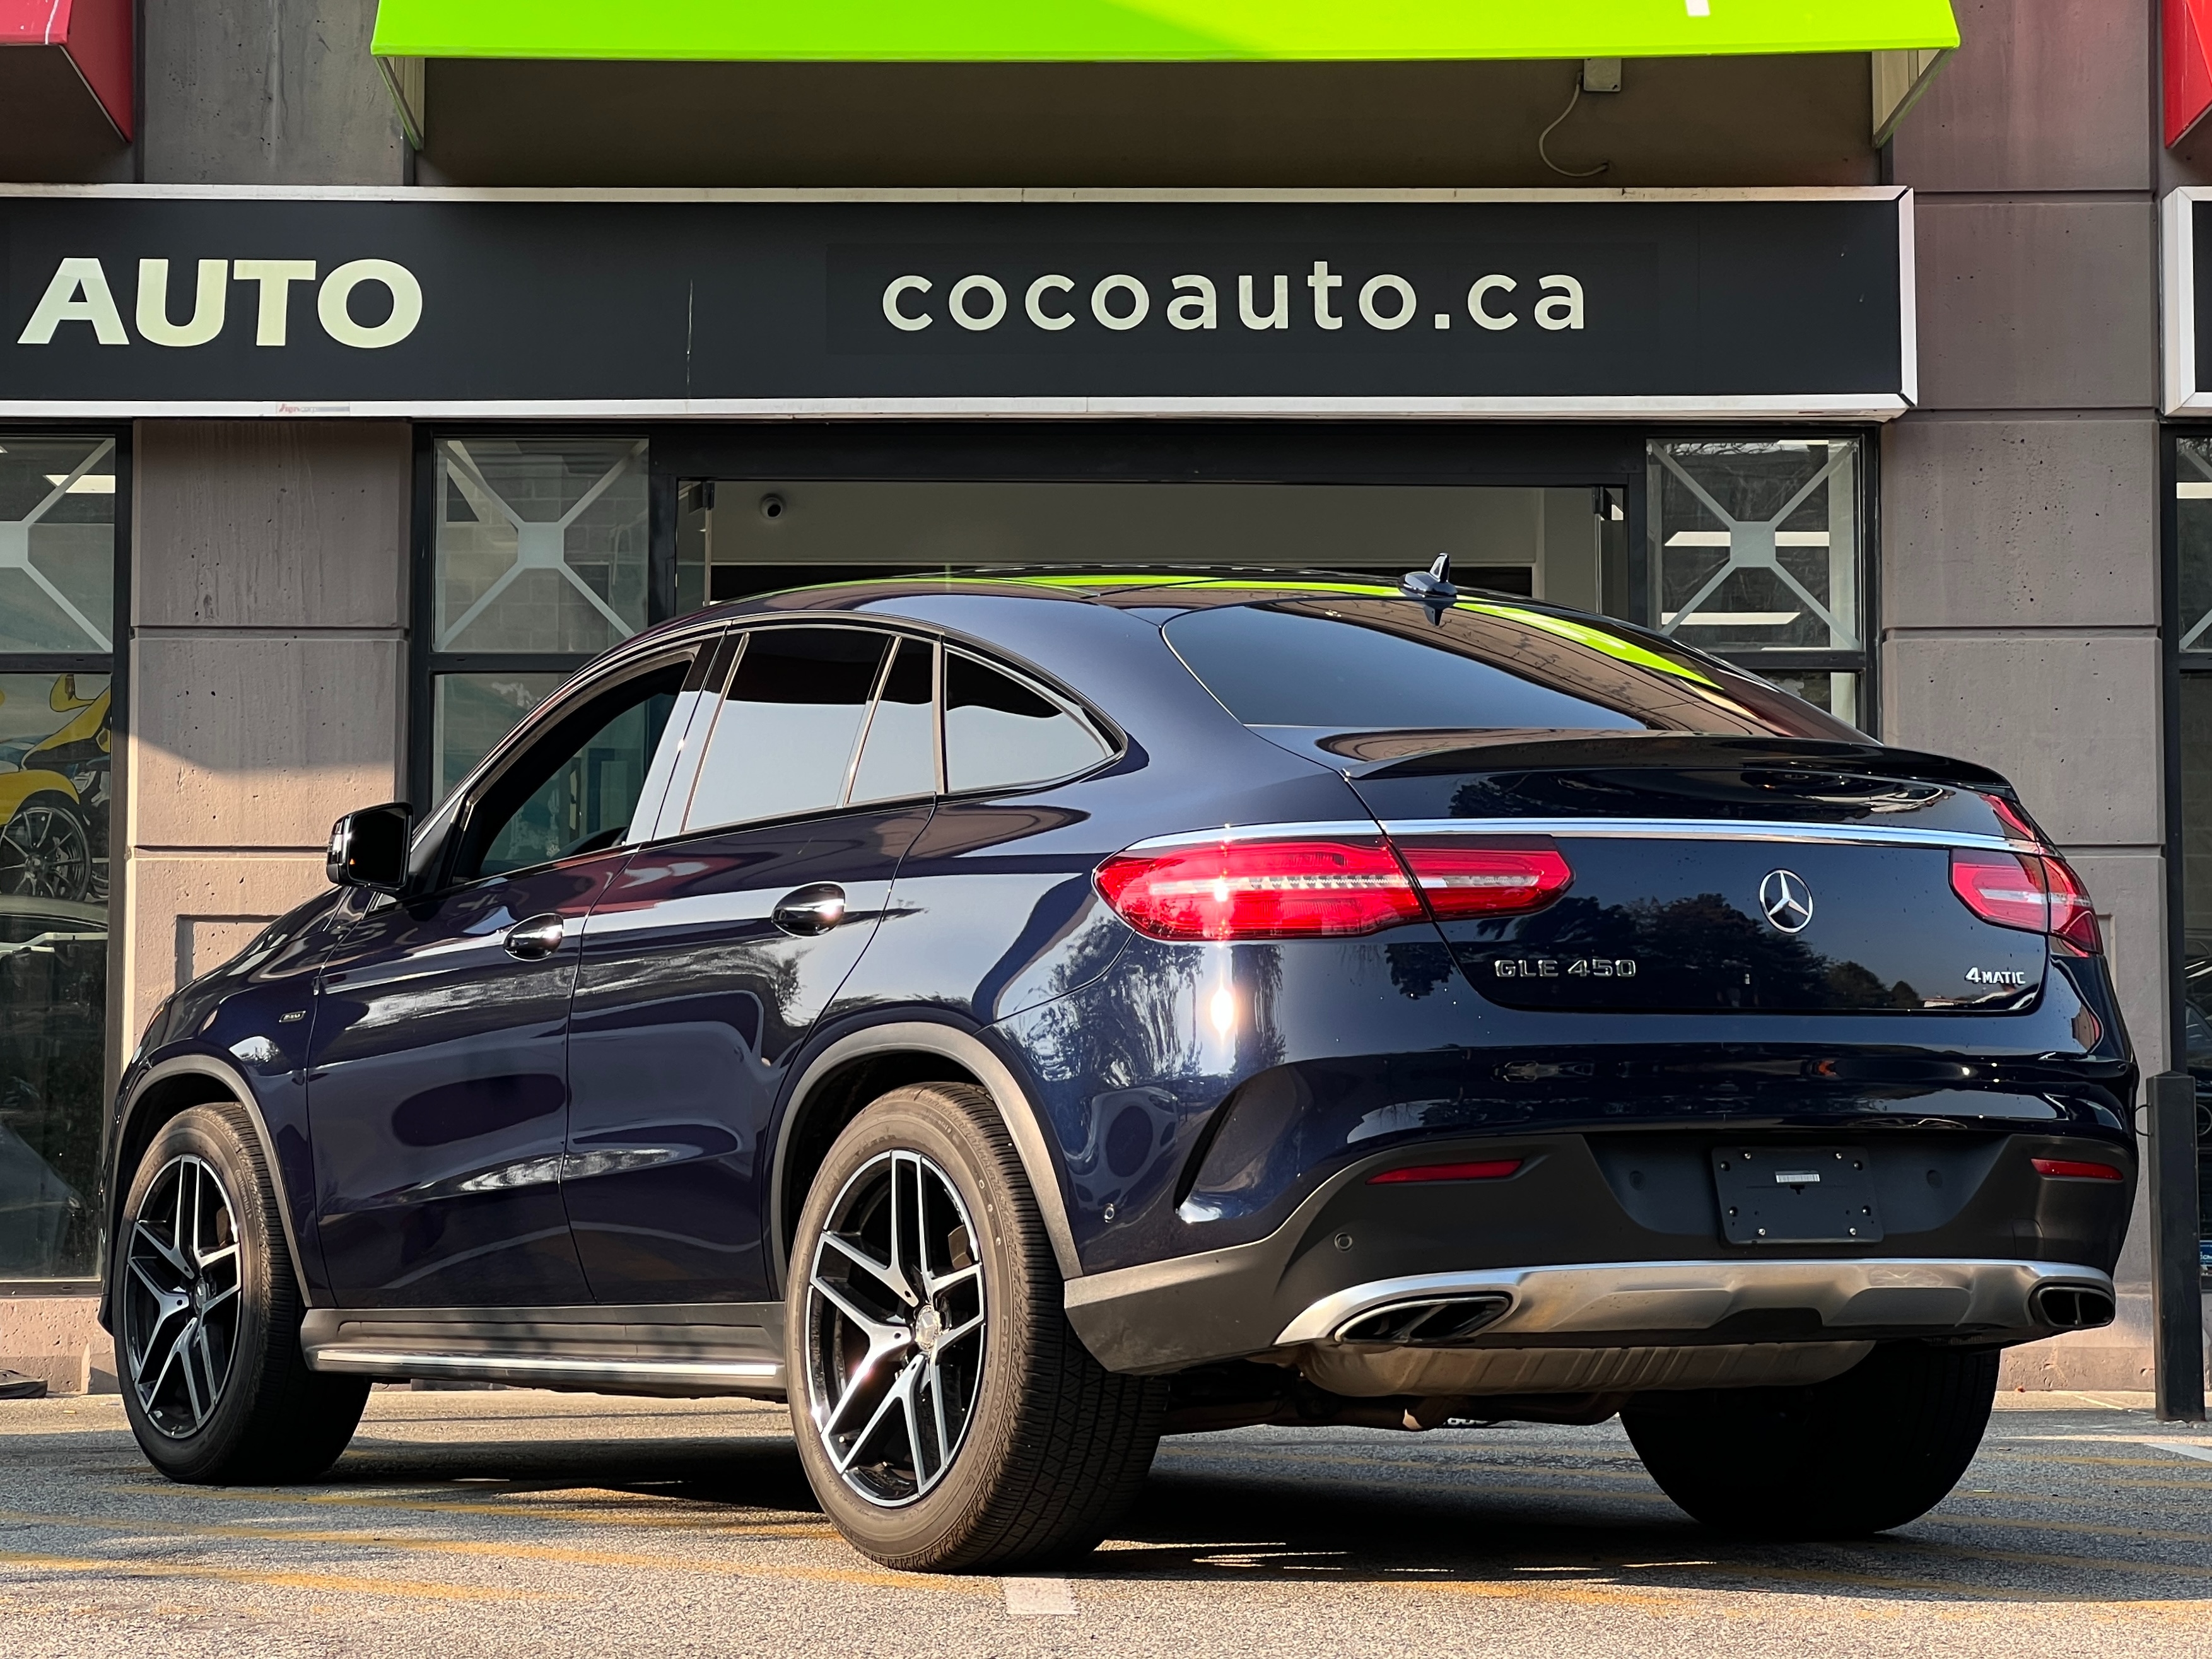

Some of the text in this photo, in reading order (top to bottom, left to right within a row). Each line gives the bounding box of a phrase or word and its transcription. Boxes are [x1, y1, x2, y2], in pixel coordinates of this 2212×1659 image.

[17, 257, 423, 349] AUTO
[882, 261, 1584, 331] cocoauto.ca
[1494, 958, 1636, 977] GLE 450
[1965, 966, 2026, 984] 4MATIC
[966, 1313, 1009, 1487] CONTINENTAL
